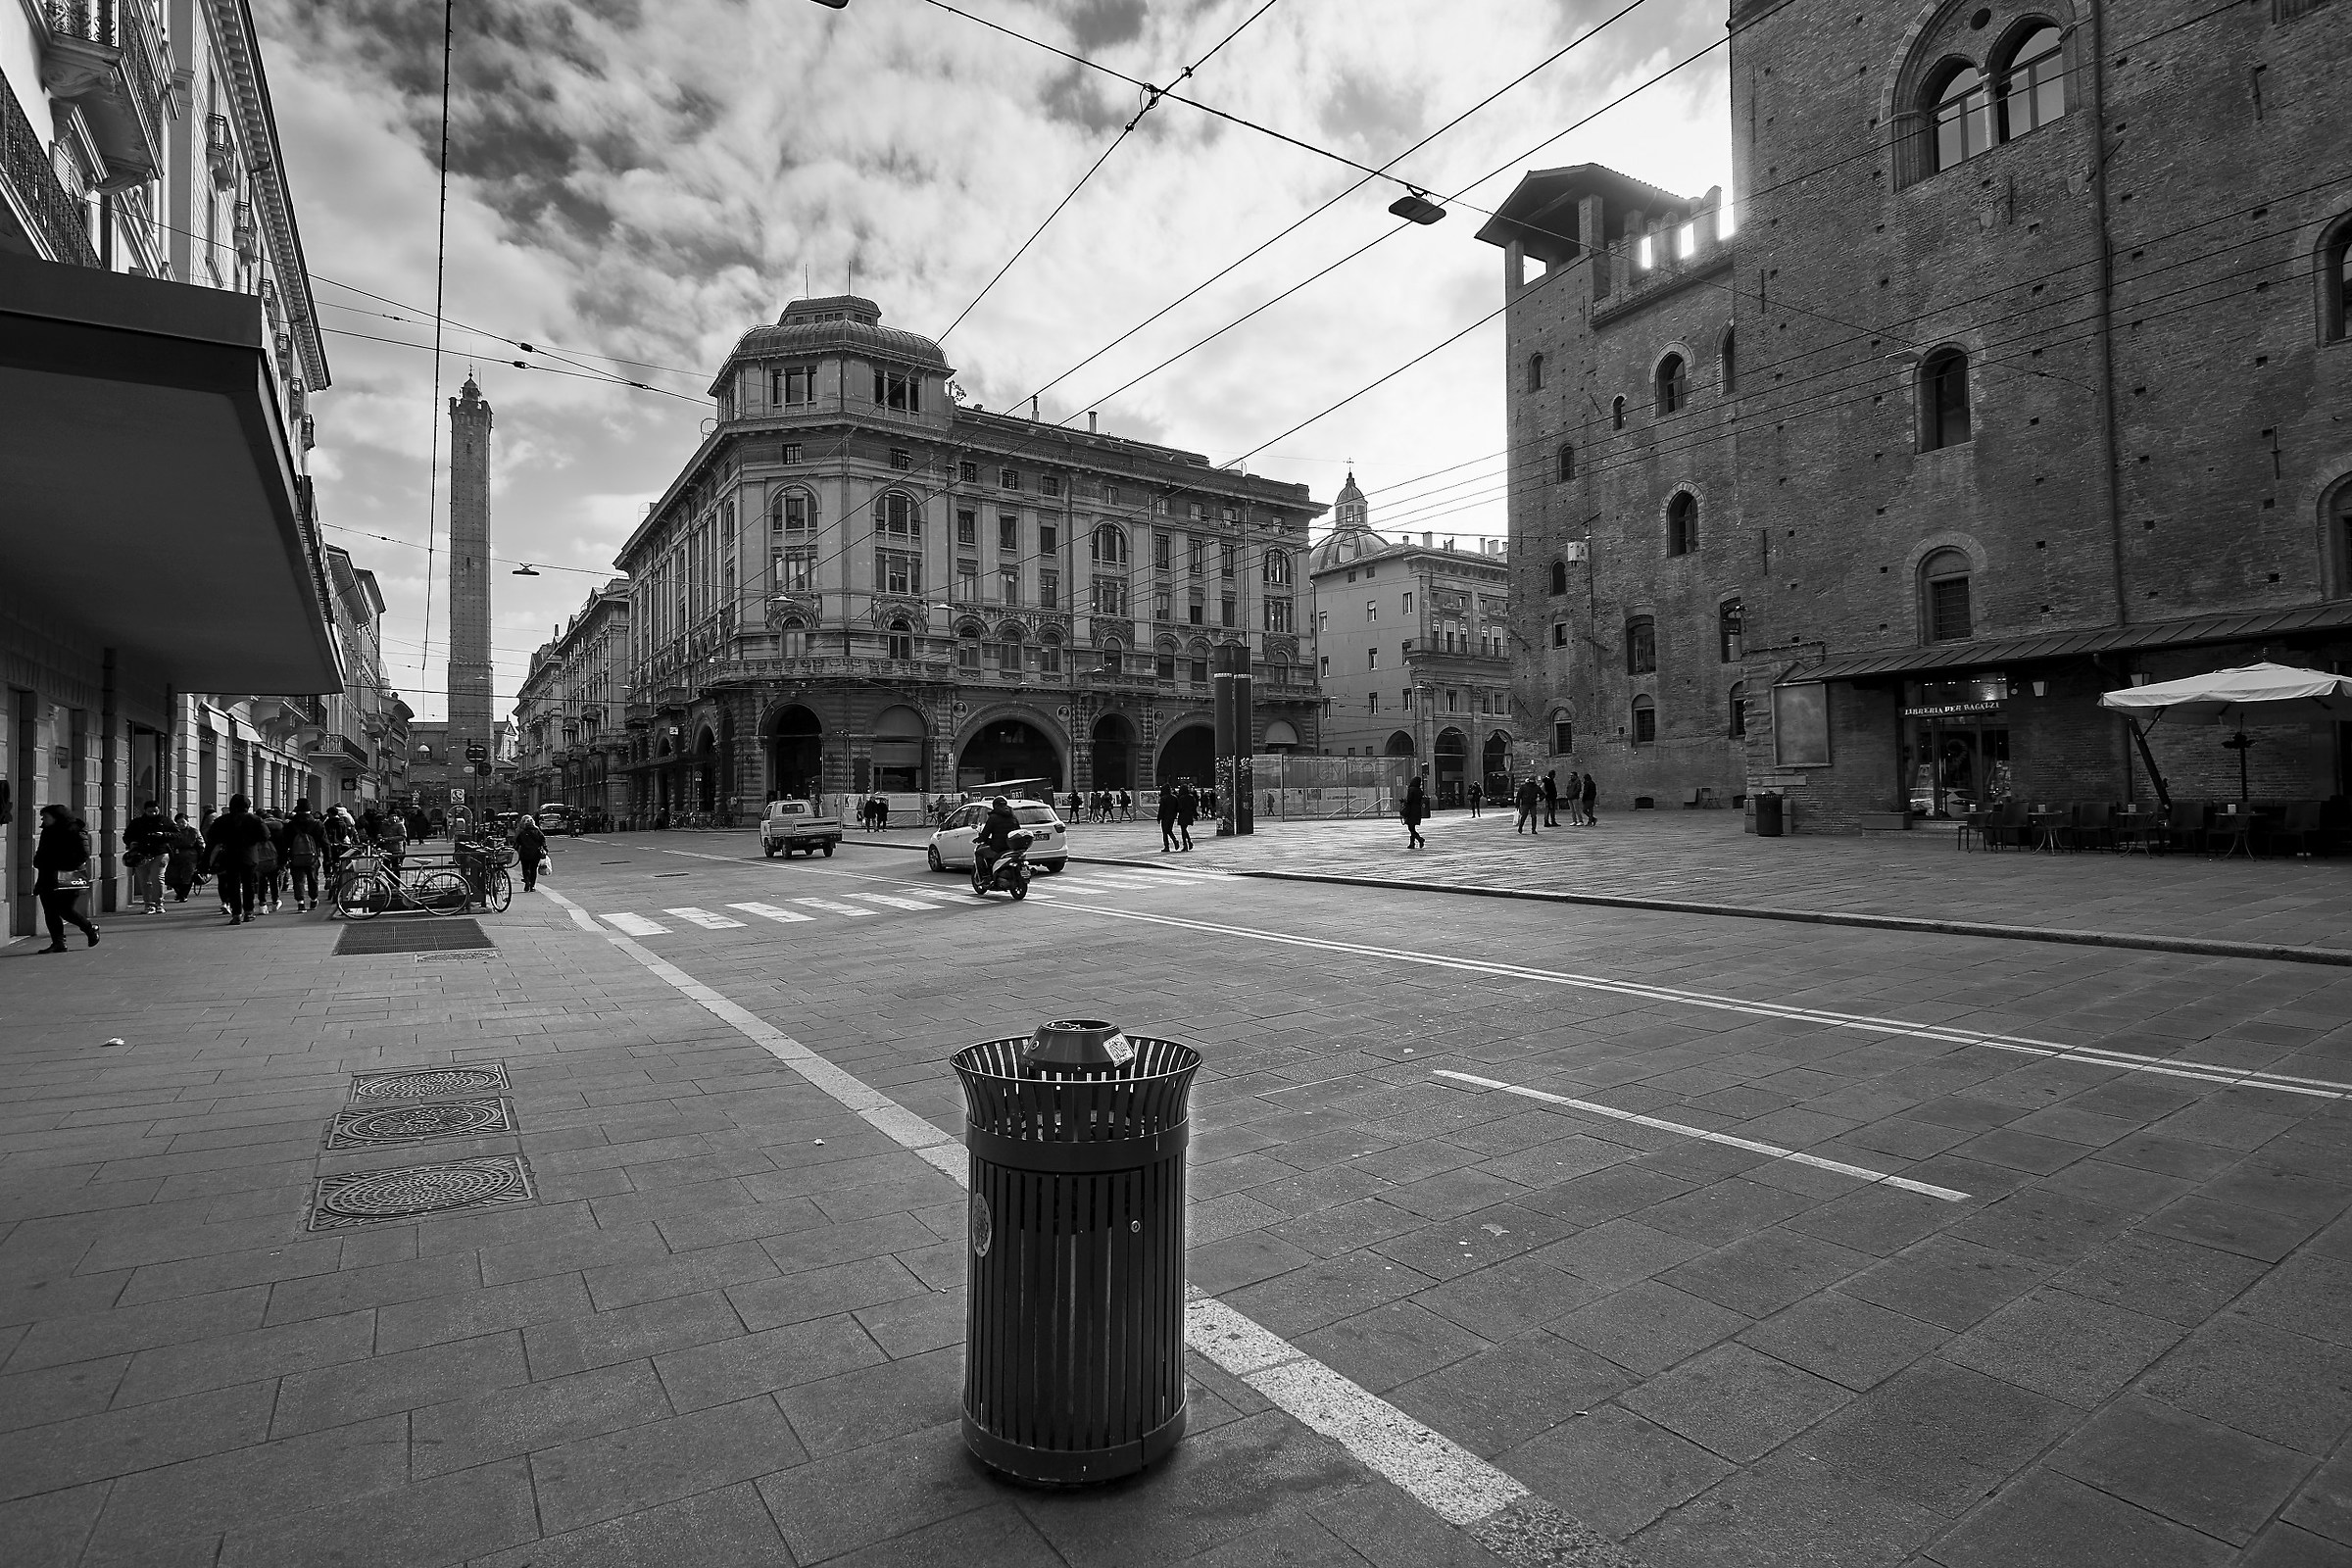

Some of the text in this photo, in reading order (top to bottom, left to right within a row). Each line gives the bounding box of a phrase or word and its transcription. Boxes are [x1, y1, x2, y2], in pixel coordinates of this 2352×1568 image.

[1904, 707, 1943, 715] LIBRERIA
[1964, 702, 1999, 711] RAGAZZI
[71, 877, 87, 886] coin
